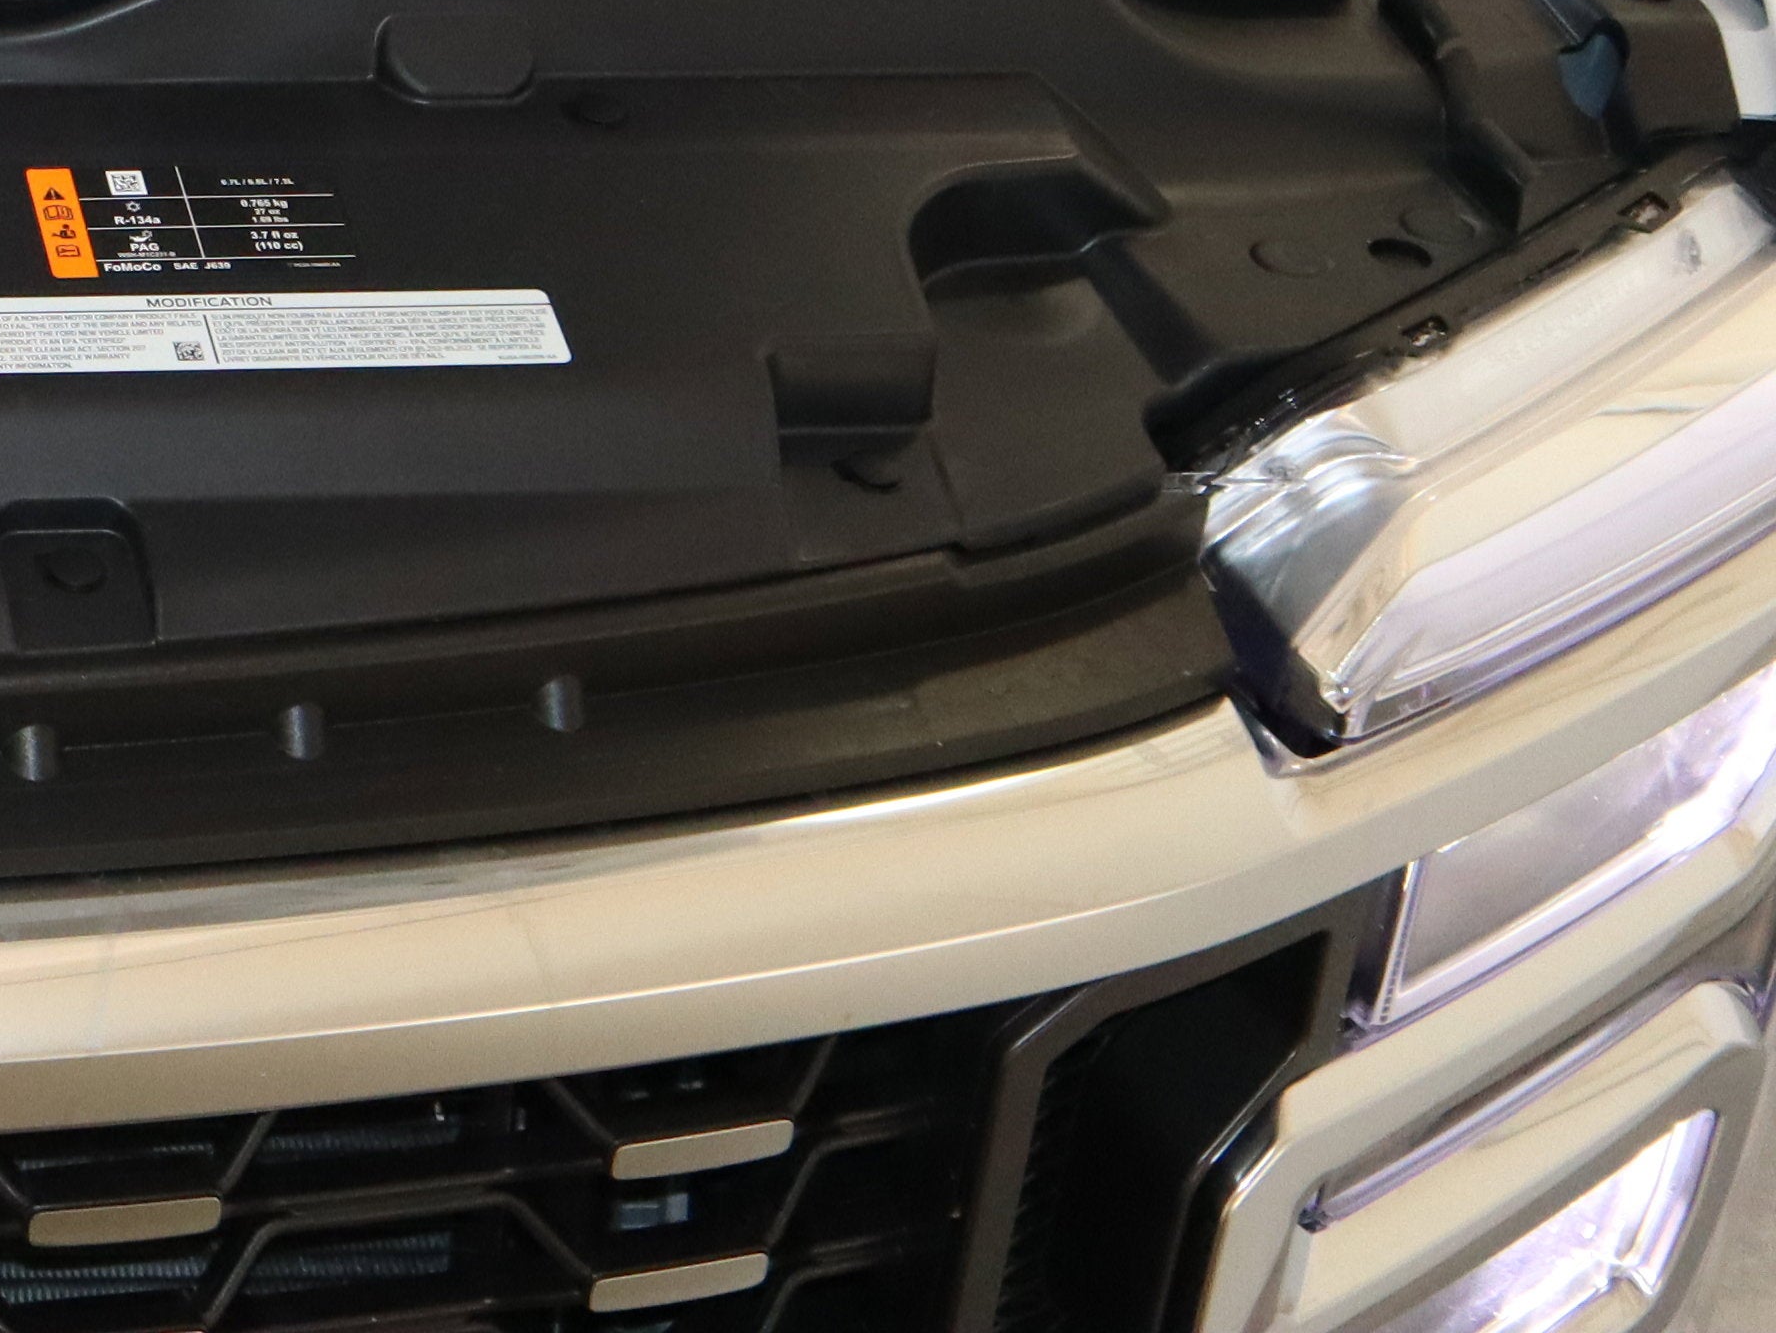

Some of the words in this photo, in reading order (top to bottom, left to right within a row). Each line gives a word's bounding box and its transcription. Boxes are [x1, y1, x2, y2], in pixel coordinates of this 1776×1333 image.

[240, 199, 271, 208] 0.765
[273, 199, 288, 209] kg
[114, 215, 161, 225] R-134a
[250, 231, 267, 240] 3.7
[271, 231, 280, 239] fl
[130, 243, 159, 252] PAG
[255, 241, 280, 251] (110
[283, 241, 303, 251] cc)
[103, 263, 162, 272] FoMoCo
[174, 262, 198, 271] SAE
[204, 262, 231, 270] J639
[146, 296, 272, 309] MODIFICATION
[94, 313, 133, 321] COMPANY
[173, 312, 196, 320] FAILS
[31, 322, 47, 330] THE
[100, 321, 128, 329] REPAIR
[166, 320, 202, 328] RELATED
[0, 338, 39, 346] PRODUCT
[18, 346, 33, 354] THE
[97, 345, 130, 353] SECTION
[9, 354, 24, 362] SEE
[84, 353, 130, 361] WARRANTY
